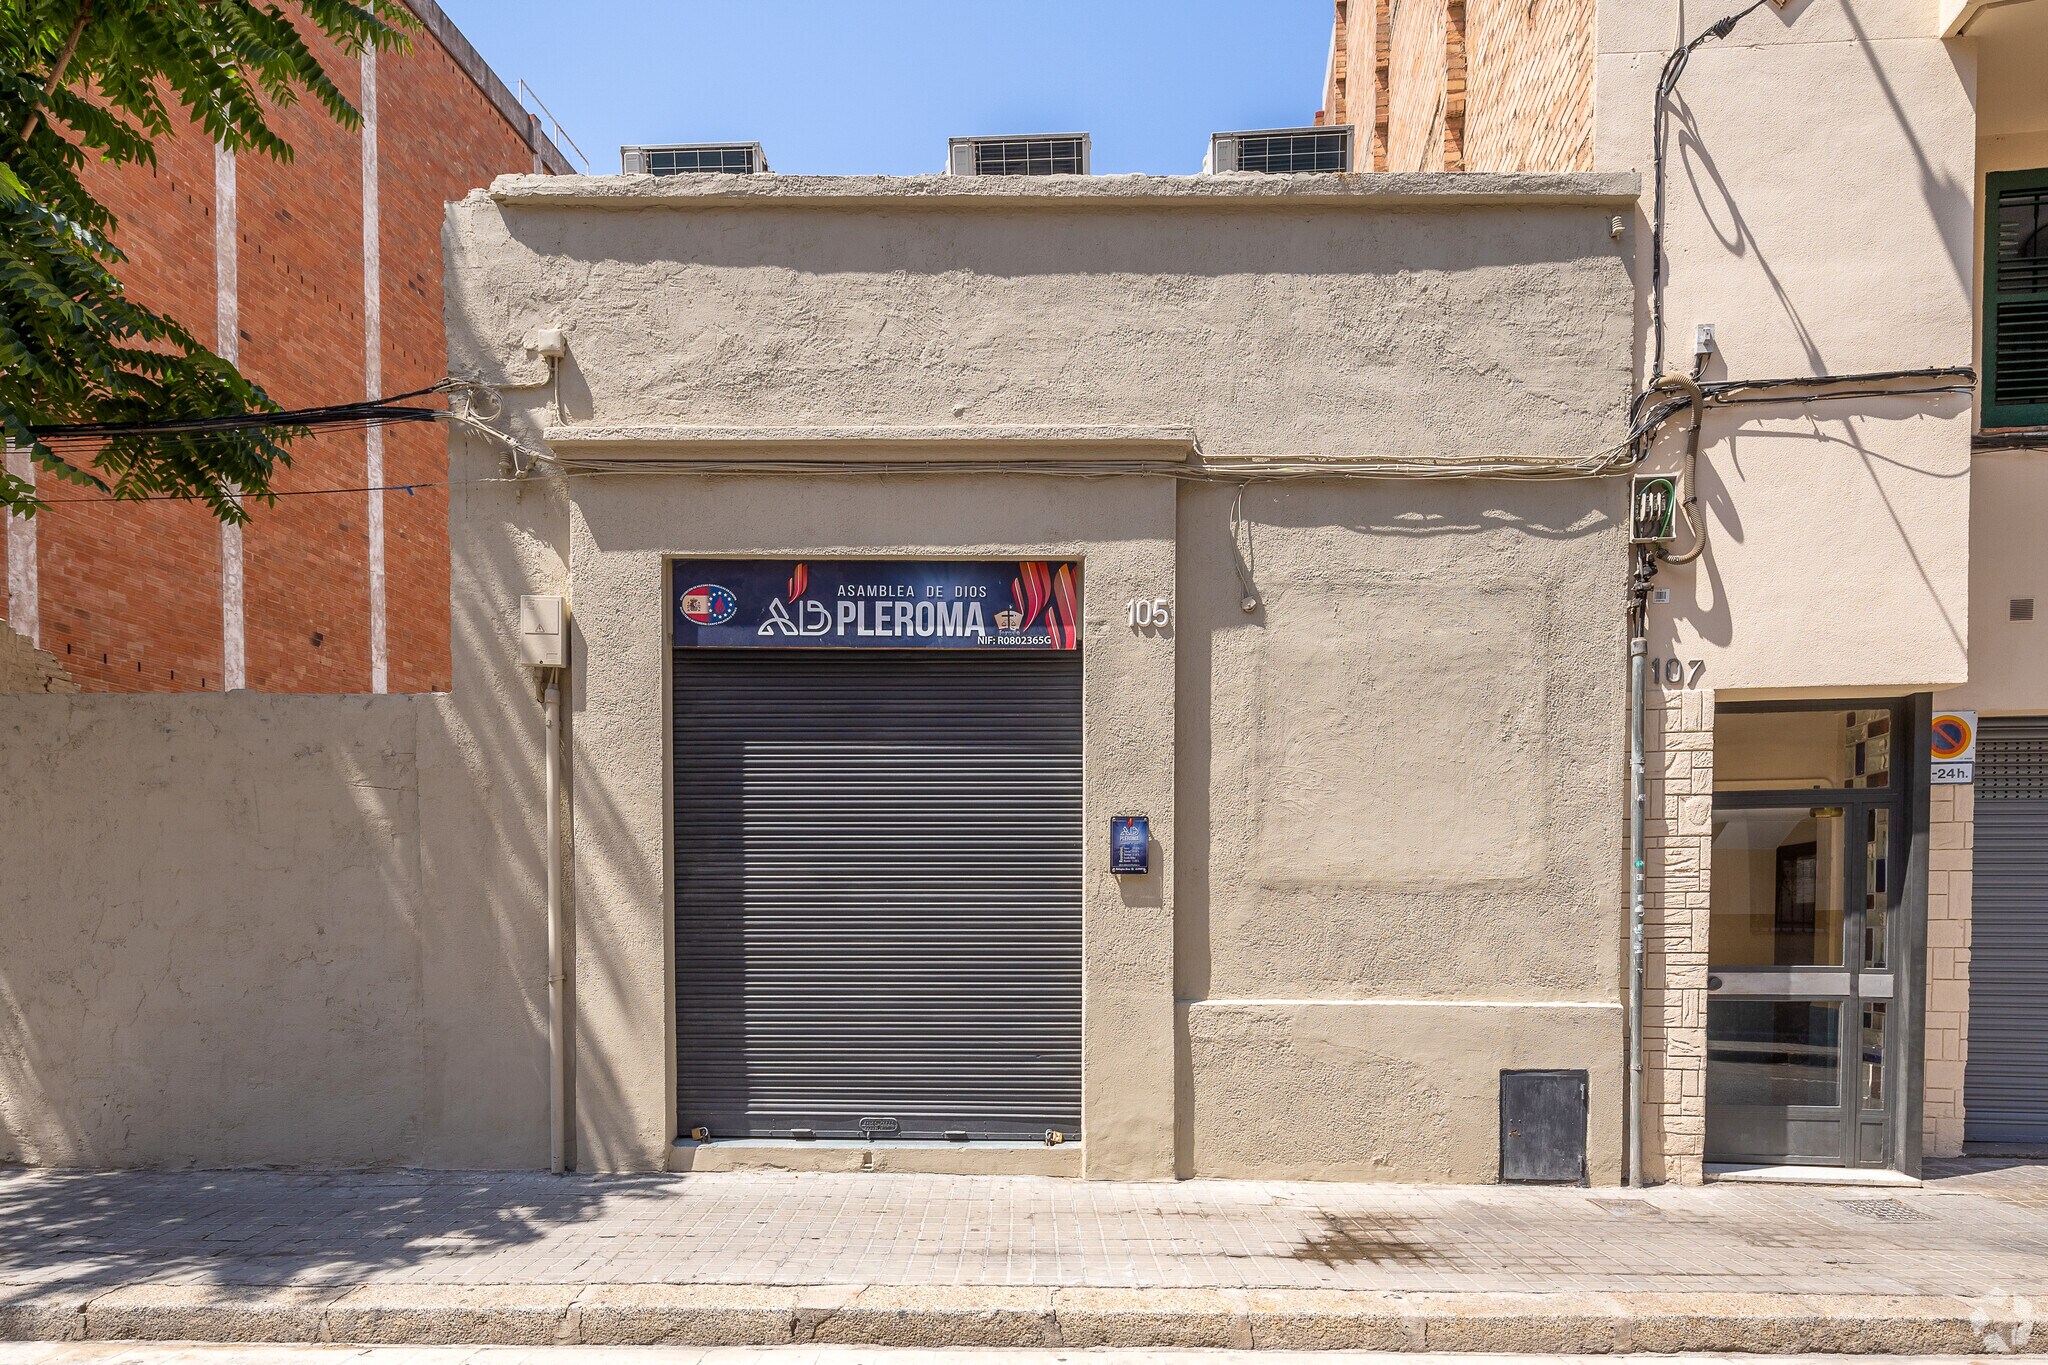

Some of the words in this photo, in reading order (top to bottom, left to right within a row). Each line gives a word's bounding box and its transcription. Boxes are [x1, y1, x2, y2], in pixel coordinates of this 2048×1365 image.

[837, 585, 915, 597] ASAMBLEA
[926, 585, 944, 597] DE
[954, 586, 987, 598] DIOS
[836, 600, 986, 637] PLEROMA
[1127, 598, 1169, 628] 105
[977, 636, 996, 645] NIF:
[997, 635, 1052, 645] R0802365G
[1651, 658, 1704, 685] 107
